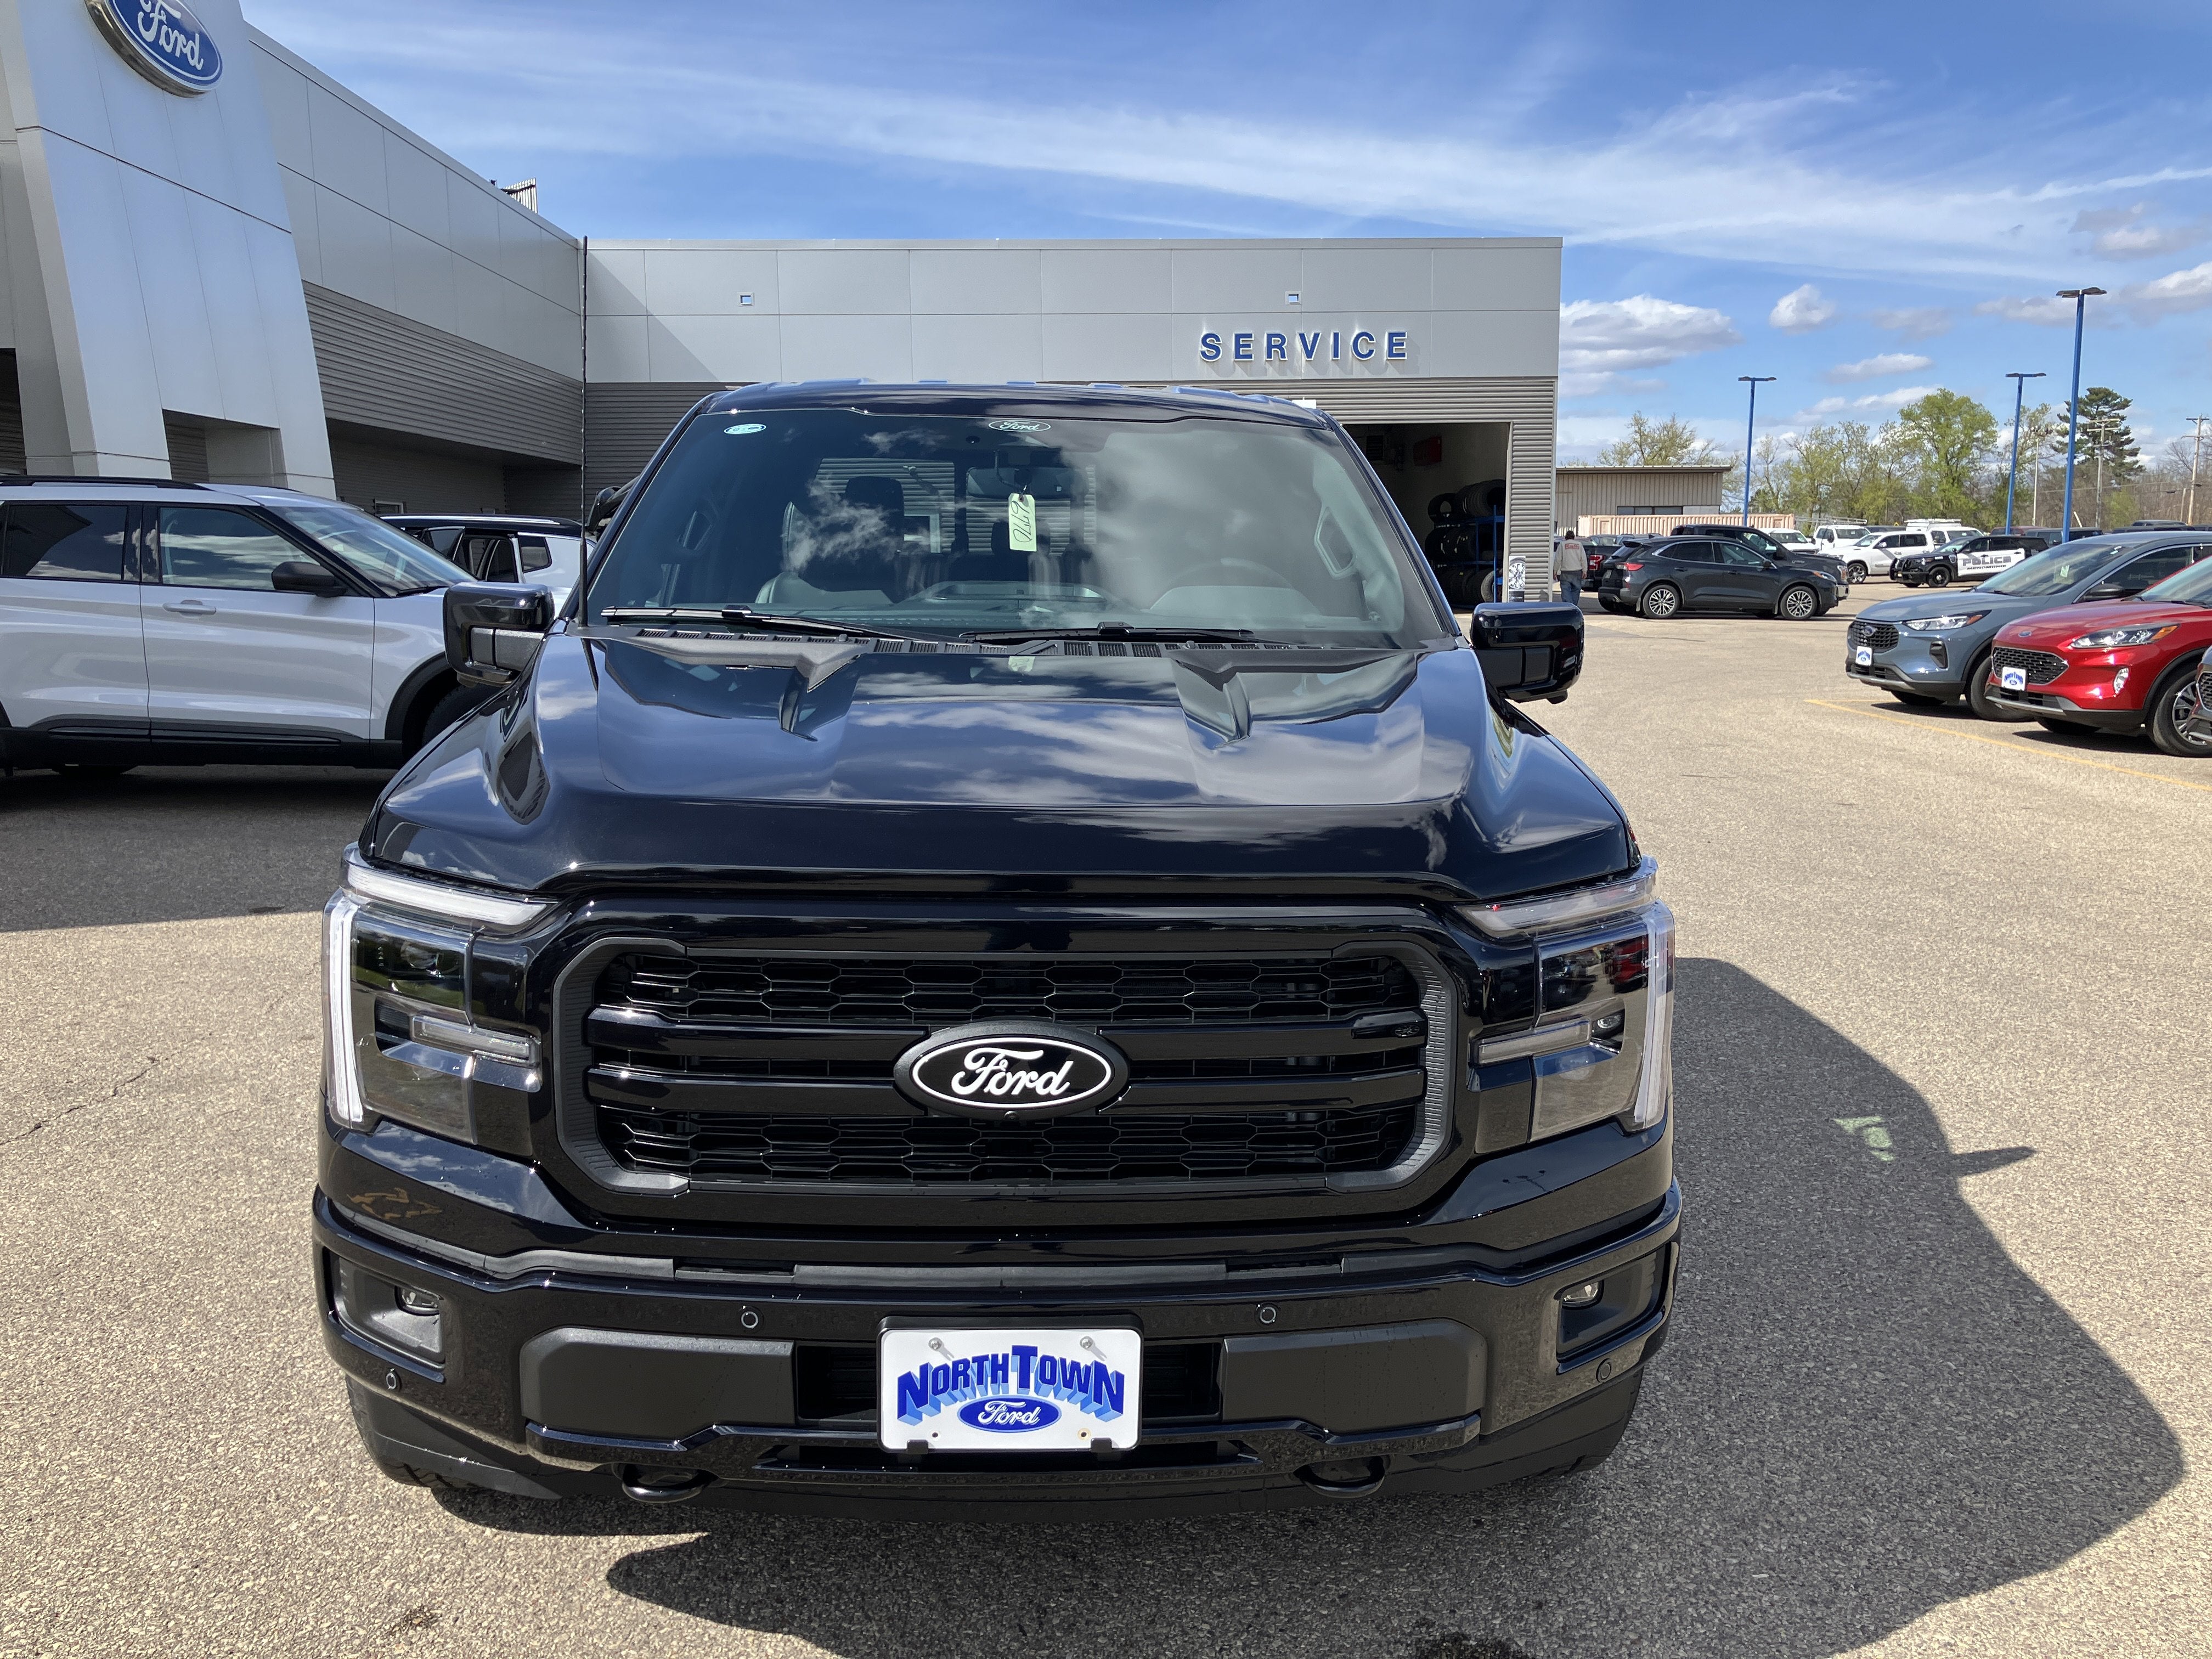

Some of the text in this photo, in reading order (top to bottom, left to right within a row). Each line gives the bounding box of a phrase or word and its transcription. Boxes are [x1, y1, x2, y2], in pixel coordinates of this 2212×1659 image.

[137, 0, 204, 70] Ford
[1200, 330, 1408, 362] SERVICE
[999, 421, 1040, 430] Ford
[1011, 500, 1032, 543] 6770
[951, 1047, 1074, 1096] Ford
[978, 1400, 1042, 1425] Ford
